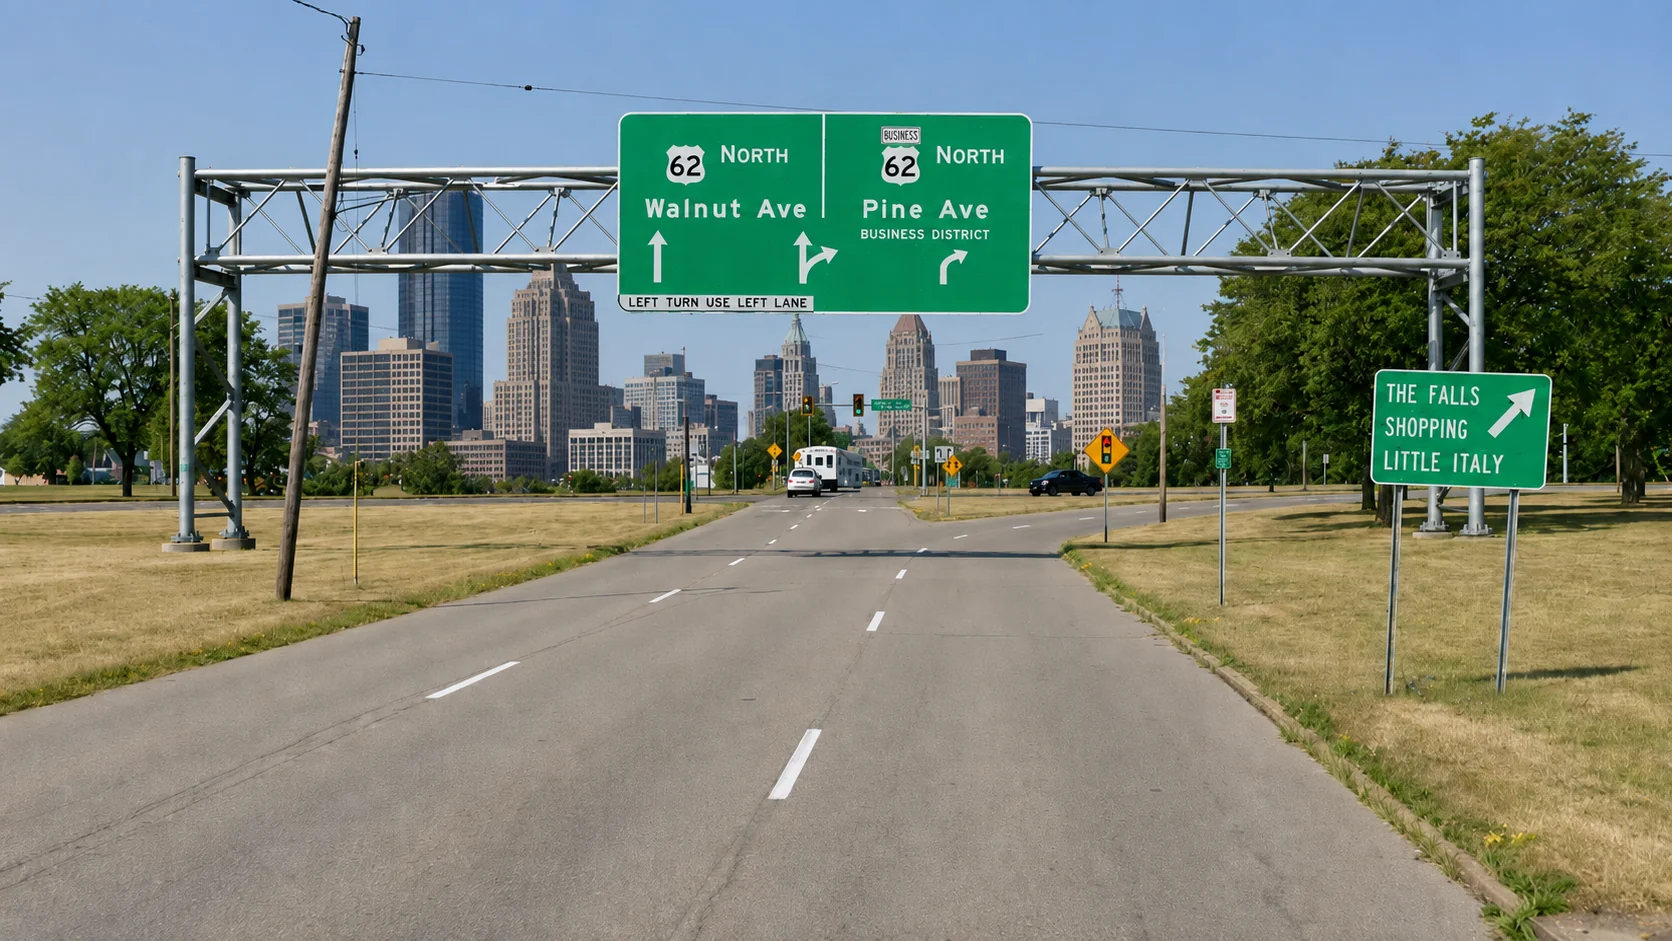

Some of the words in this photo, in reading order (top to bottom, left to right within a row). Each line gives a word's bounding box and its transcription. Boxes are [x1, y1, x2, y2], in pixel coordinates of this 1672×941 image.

[884, 130, 918, 141] BUSINESS
[670, 155, 701, 177] 62
[721, 144, 788, 164] NORTH
[885, 155, 916, 177] 62
[937, 145, 1005, 164] NORTH
[645, 198, 741, 218] Walnut
[757, 198, 807, 218] Ave
[863, 199, 923, 219] Pine
[939, 199, 989, 219] Ave
[861, 229, 924, 240] BUSINESS
[932, 229, 990, 240] DISTRICT
[629, 297, 659, 308] LEFT
[666, 297, 699, 308] TURN
[706, 297, 730, 308] USE
[738, 297, 767, 308] LEFT
[775, 297, 807, 308] LANE
[1386, 383, 1417, 404] THE
[1429, 385, 1480, 406] FALLS
[1385, 416, 1468, 439] SHOPPING
[1384, 450, 1441, 472] LITTLE
[1453, 452, 1504, 474] ITALY
